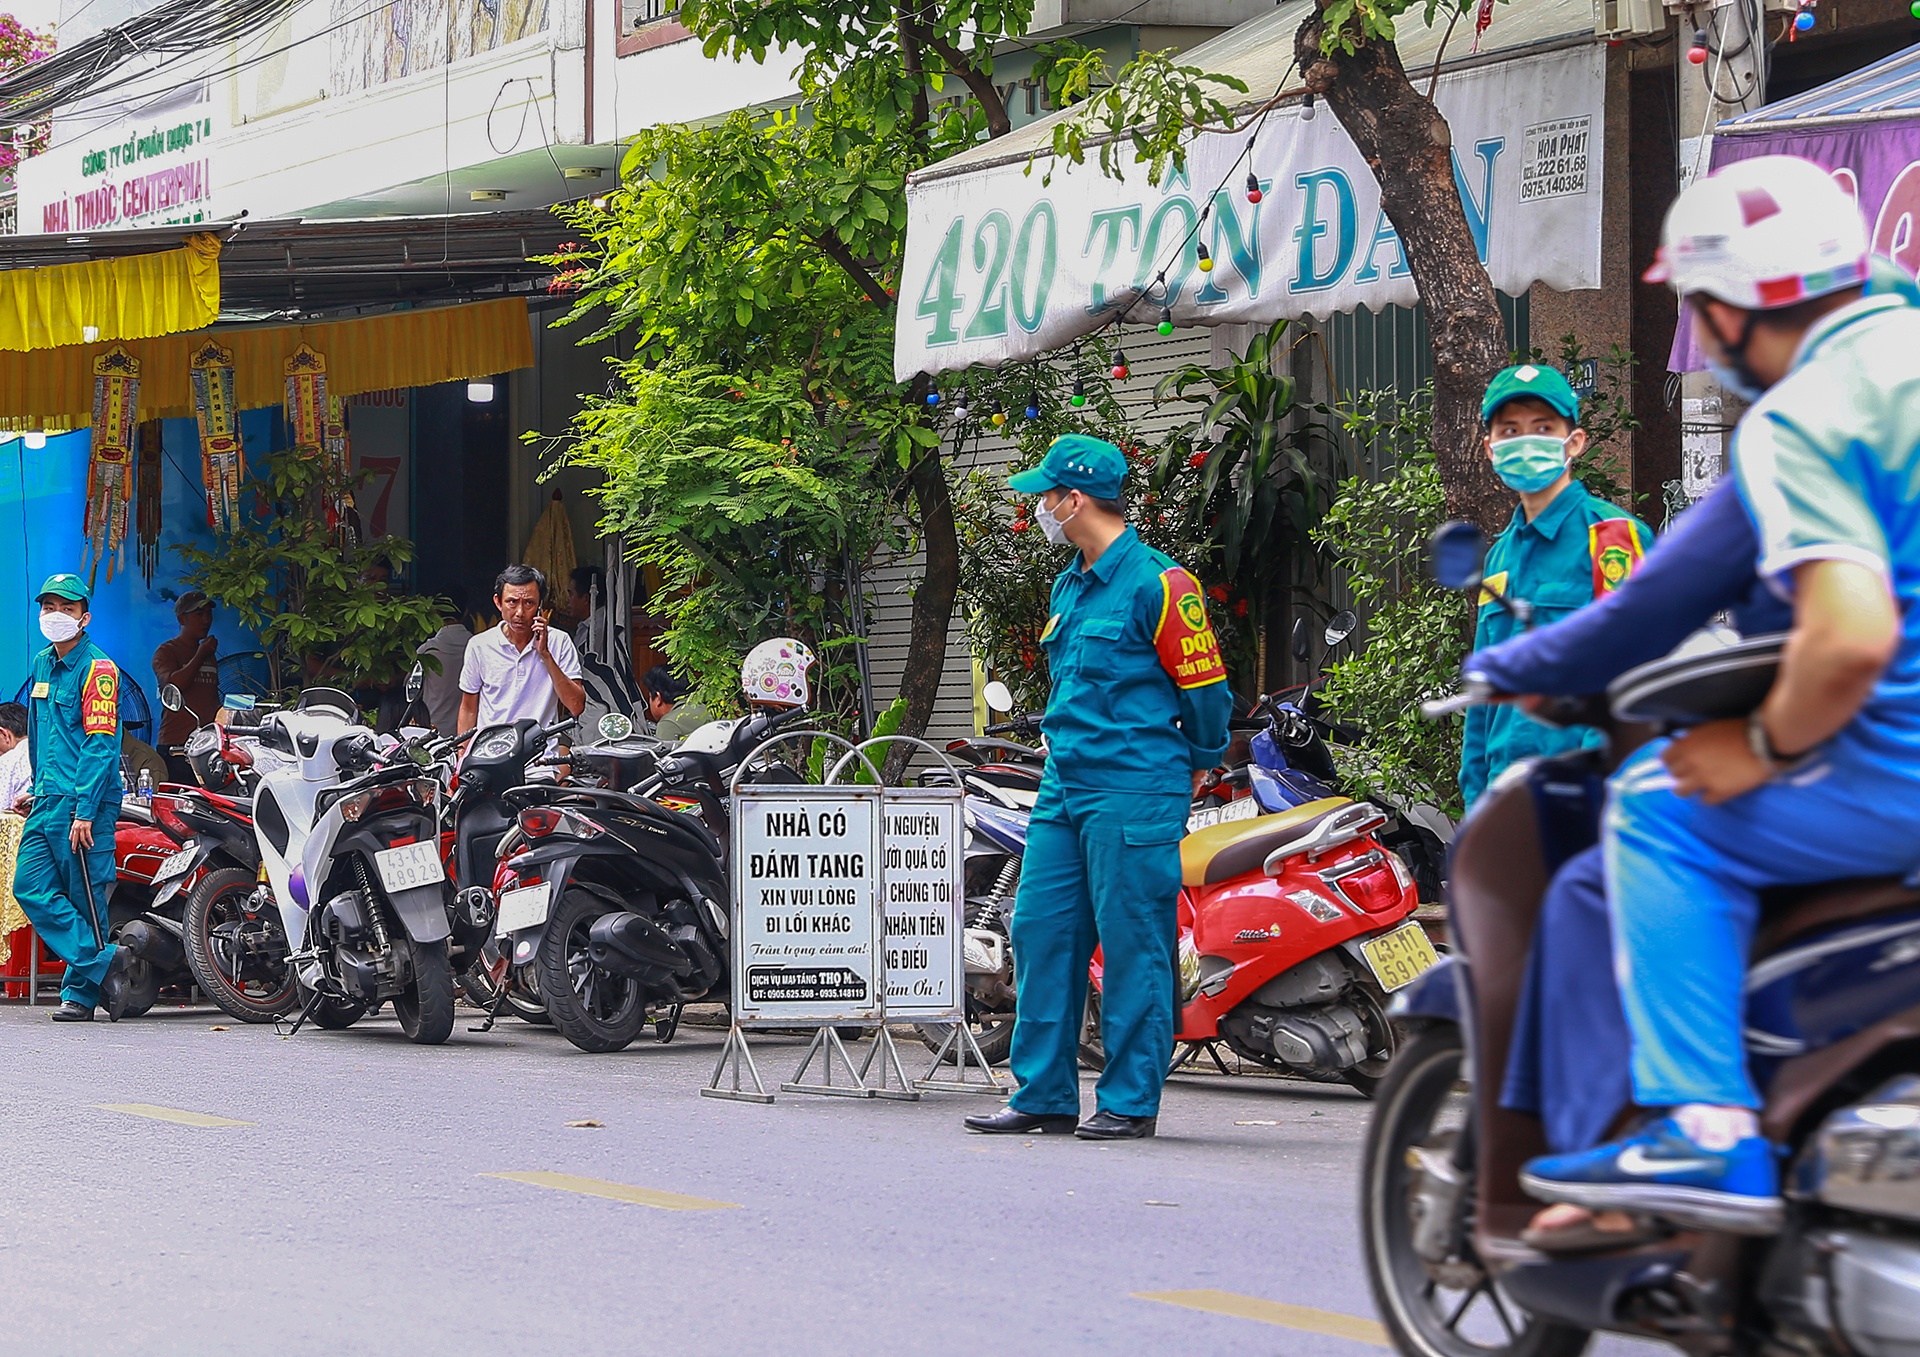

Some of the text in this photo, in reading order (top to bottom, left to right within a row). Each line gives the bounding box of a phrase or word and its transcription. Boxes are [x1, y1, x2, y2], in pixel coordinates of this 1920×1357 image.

[82, 149, 107, 177] CÔNG
[109, 145, 121, 168] TY
[122, 131, 135, 165] CỔ
[137, 126, 165, 160] PHẦN
[166, 122, 193, 153] DƯỢC
[1537, 130, 1587, 160] HÒA PHÁT
[1557, 155, 1586, 174] 61.68
[1521, 173, 1584, 199] 0975.140384
[43, 191, 69, 233] NHÀ
[75, 171, 117, 231] THUỐC
[916, 198, 1058, 348] 420
[1081, 161, 1273, 317] TÔN
[1195, 657, 1212, 673] TRA
[766, 807, 846, 837] NHÀ CÓ
[894, 811, 939, 840] NGUYỆN
[387, 847, 427, 869] 43-K1
[750, 848, 864, 878] ĐÁM TANG
[905, 845, 928, 871] QUÁ
[931, 842, 947, 869] CỐ
[387, 863, 439, 888] 489.29
[760, 885, 856, 906] XIN VUI LÒNG
[890, 878, 949, 903] CHÚNG TÔI
[766, 910, 851, 933] ĐI LỐI KHÁC
[885, 909, 945, 940] NHẬN TIỀN
[750, 943, 868, 958] Trân trọng cảm ơn!
[901, 941, 928, 969] ĐIẾU
[1372, 929, 1419, 963] 43-M1
[751, 975, 769, 987] DỊCH
[770, 974, 781, 987] VỤ
[818, 972, 840, 987] THỌ
[1383, 951, 1433, 985] 5913
[753, 989, 766, 999] ĐT:
